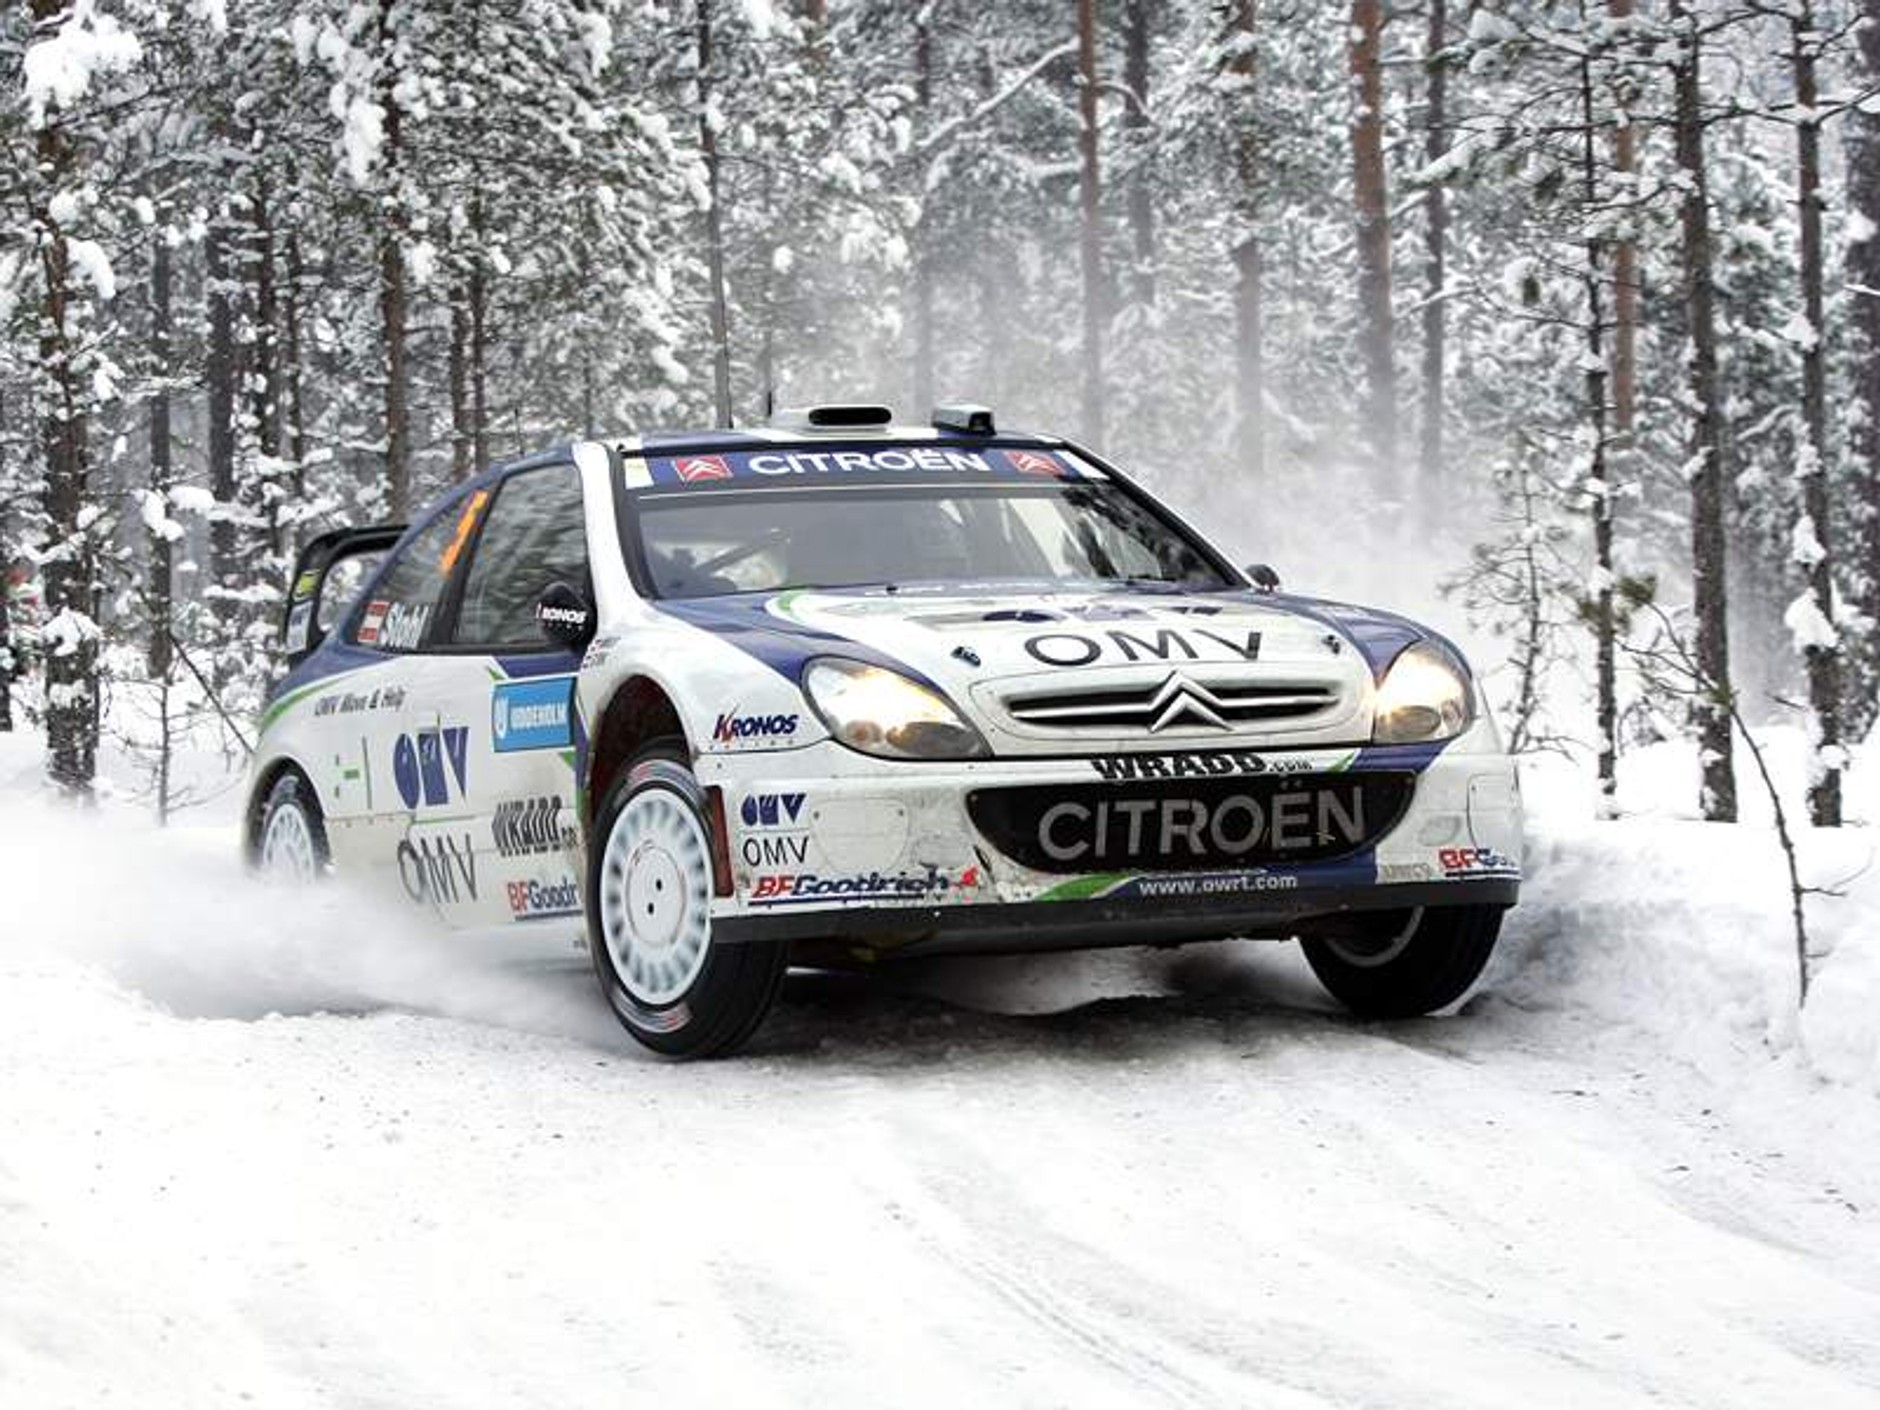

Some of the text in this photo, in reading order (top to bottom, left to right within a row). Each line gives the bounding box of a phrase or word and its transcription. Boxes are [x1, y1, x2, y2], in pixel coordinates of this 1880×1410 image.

[748, 449, 989, 475] CITROËN
[1024, 629, 1262, 667] OMV
[712, 703, 799, 741] KRONOS
[1038, 778, 1366, 864] CITROËN
[398, 833, 477, 902] OMV
[743, 836, 809, 867] OMV
[752, 871, 947, 898] BFGoodrich
[1140, 873, 1299, 896] www.owrt.com
